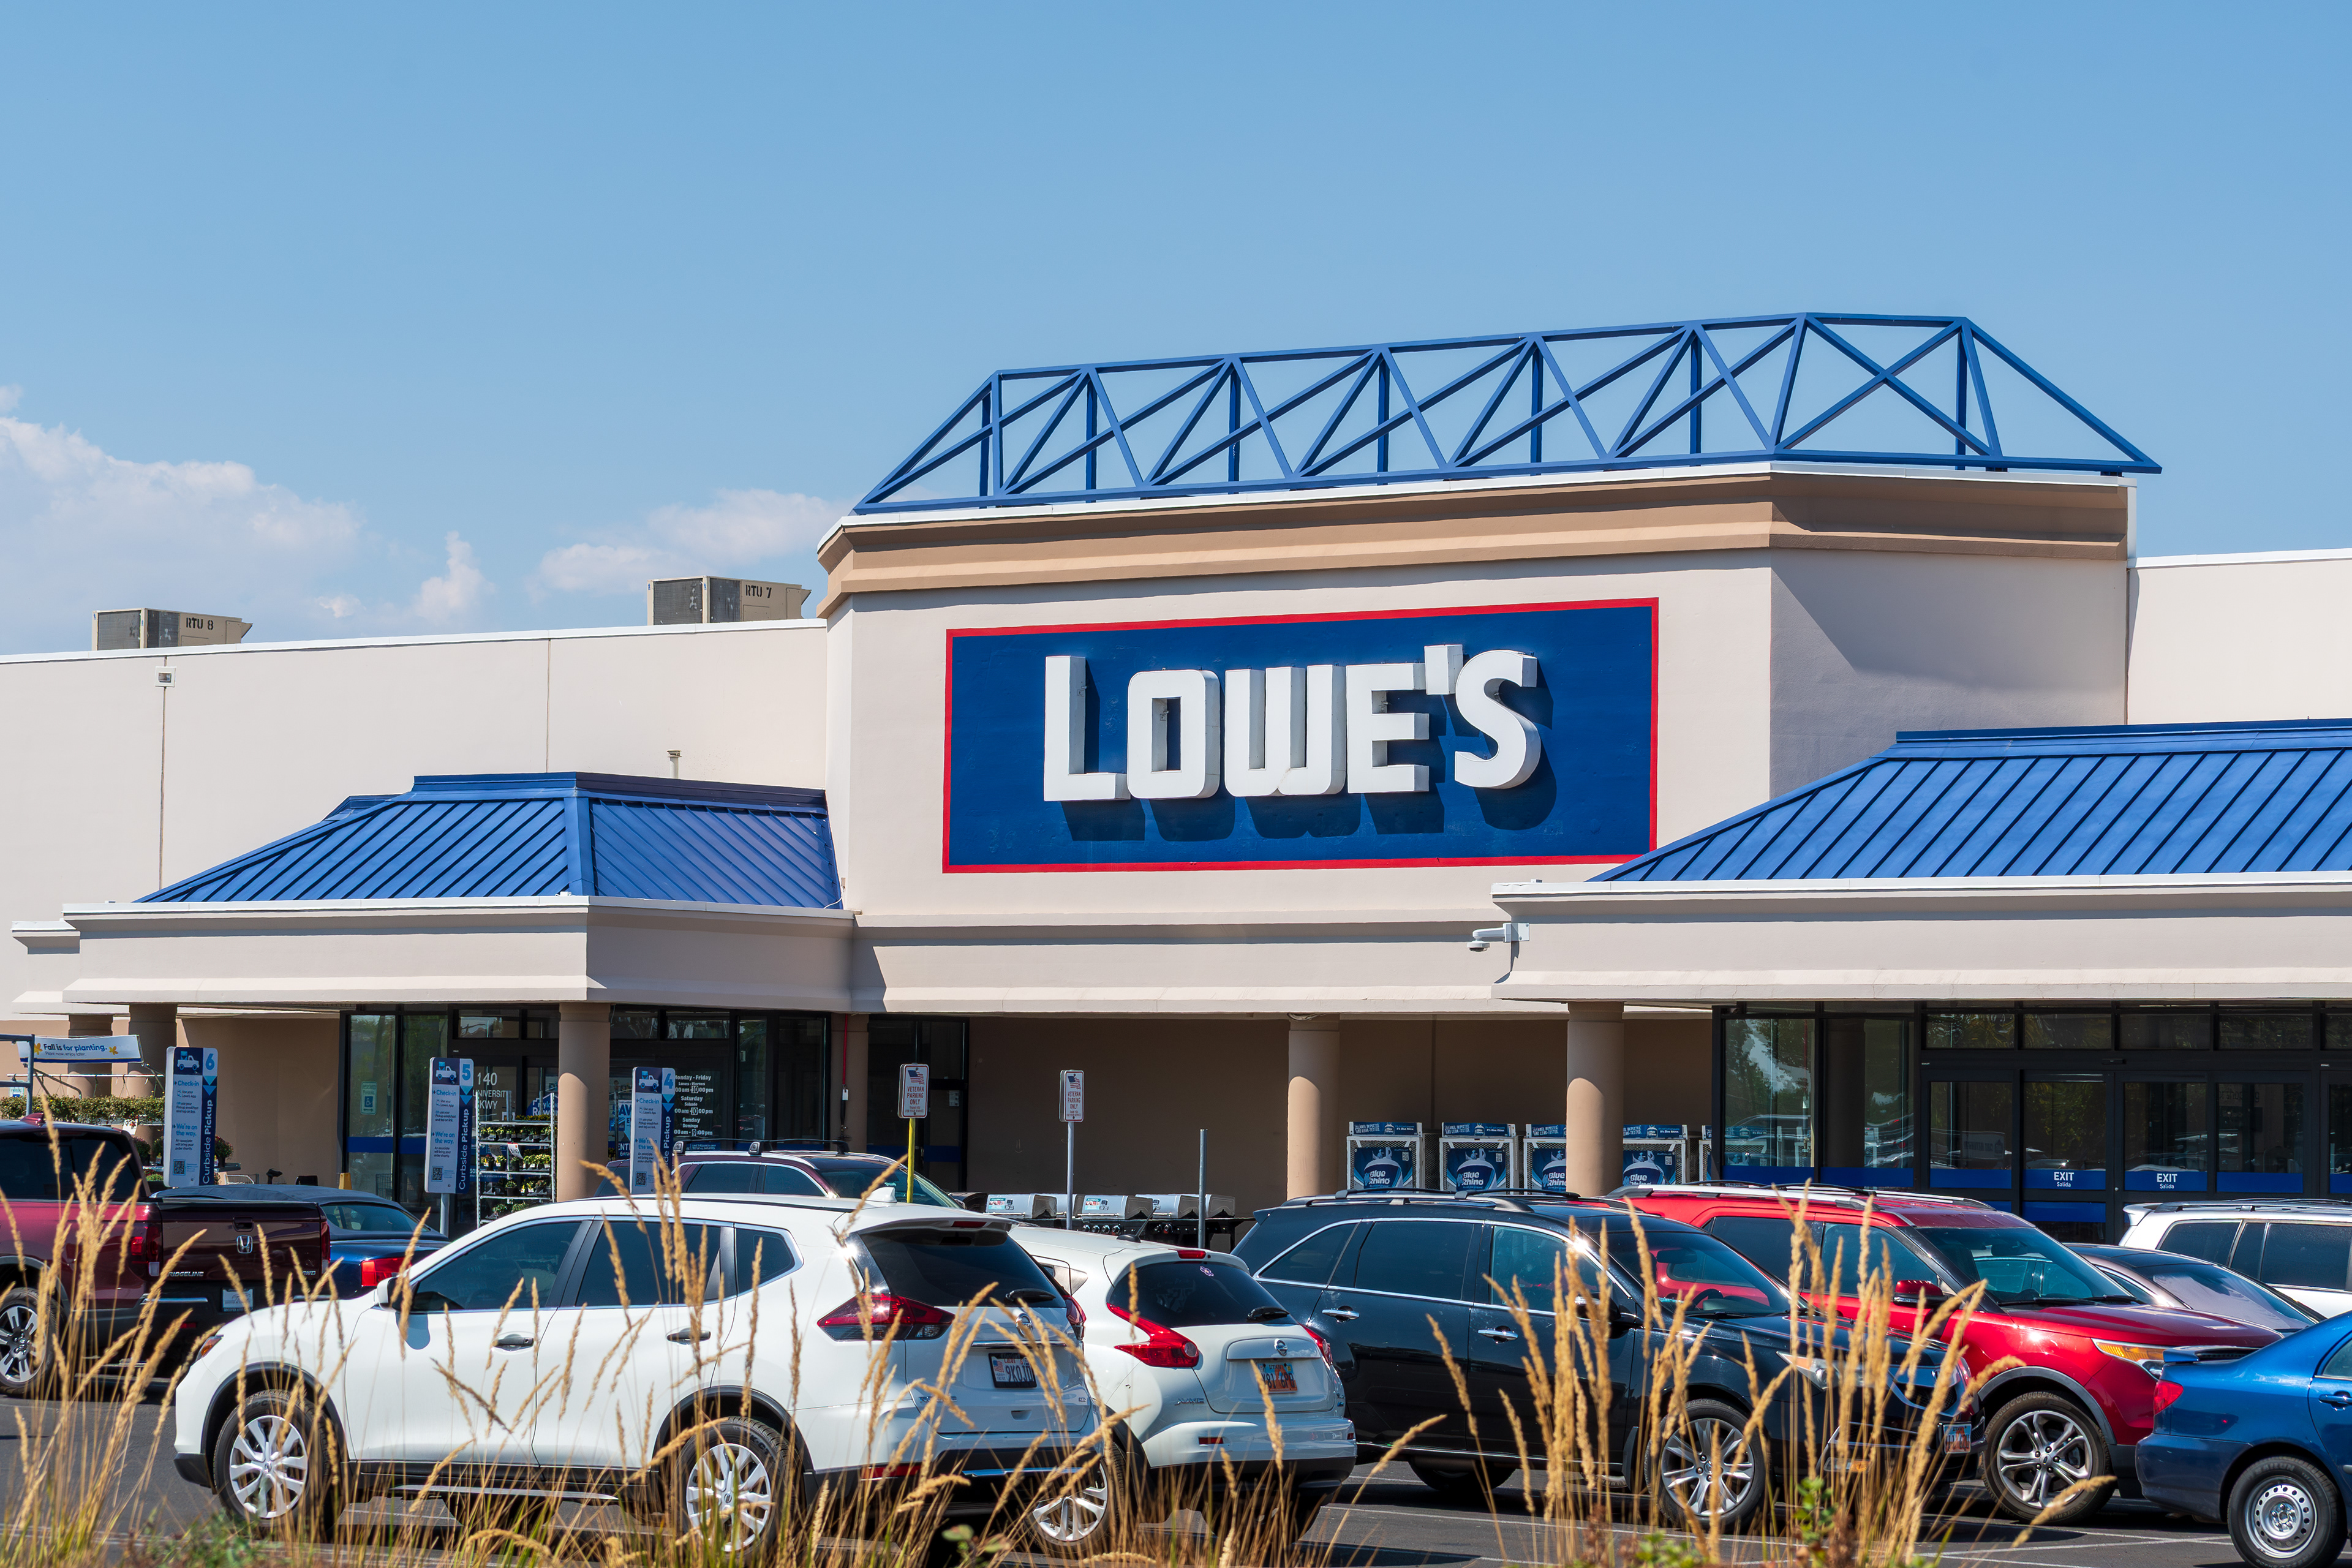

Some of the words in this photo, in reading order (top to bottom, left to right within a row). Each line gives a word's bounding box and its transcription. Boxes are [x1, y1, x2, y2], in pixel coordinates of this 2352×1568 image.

[745, 584, 763, 597] RTU
[766, 587, 772, 598] 7
[186, 617, 203, 629] RTU
[208, 620, 214, 630] 8
[1044, 644, 1540, 801] LOWE'S
[74, 1044, 108, 1052] planting.
[205, 1053, 215, 1070] 6
[462, 1064, 470, 1080] 5
[477, 1072, 497, 1085] 140
[664, 1073, 673, 1089] 4
[475, 1100, 498, 1109] KWY
[205, 1099, 213, 1134] Pickup
[459, 1145, 467, 1189] Curbside
[2054, 1172, 2074, 1181] EXIT
[2157, 1174, 2177, 1182] EXIT
